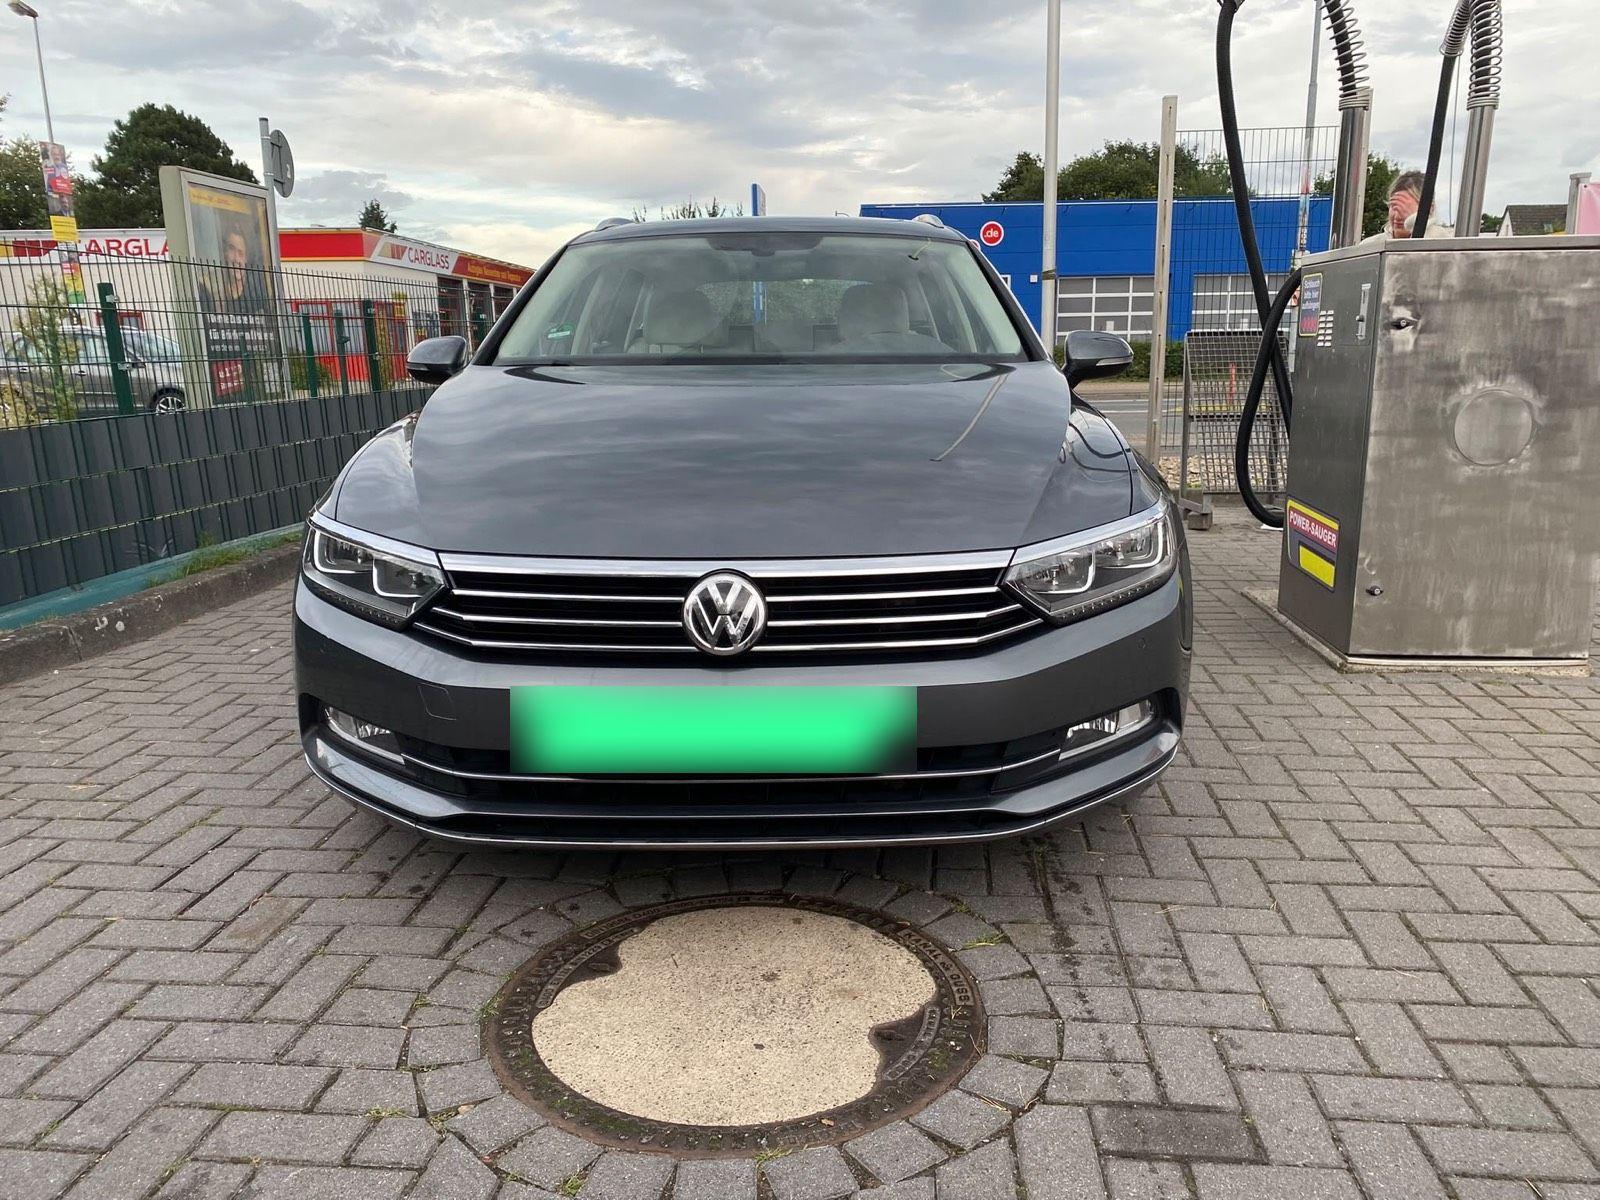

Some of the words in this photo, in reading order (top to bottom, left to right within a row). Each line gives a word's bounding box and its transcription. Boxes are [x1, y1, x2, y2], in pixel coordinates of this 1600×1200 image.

[984, 228, 999, 238] .de
[78, 238, 169, 256] ARGL
[408, 247, 450, 270] CARGLASS
[1289, 511, 1337, 548] POWER-SAUGER
[689, 577, 760, 650] VW
[903, 932, 942, 960] KANAL
